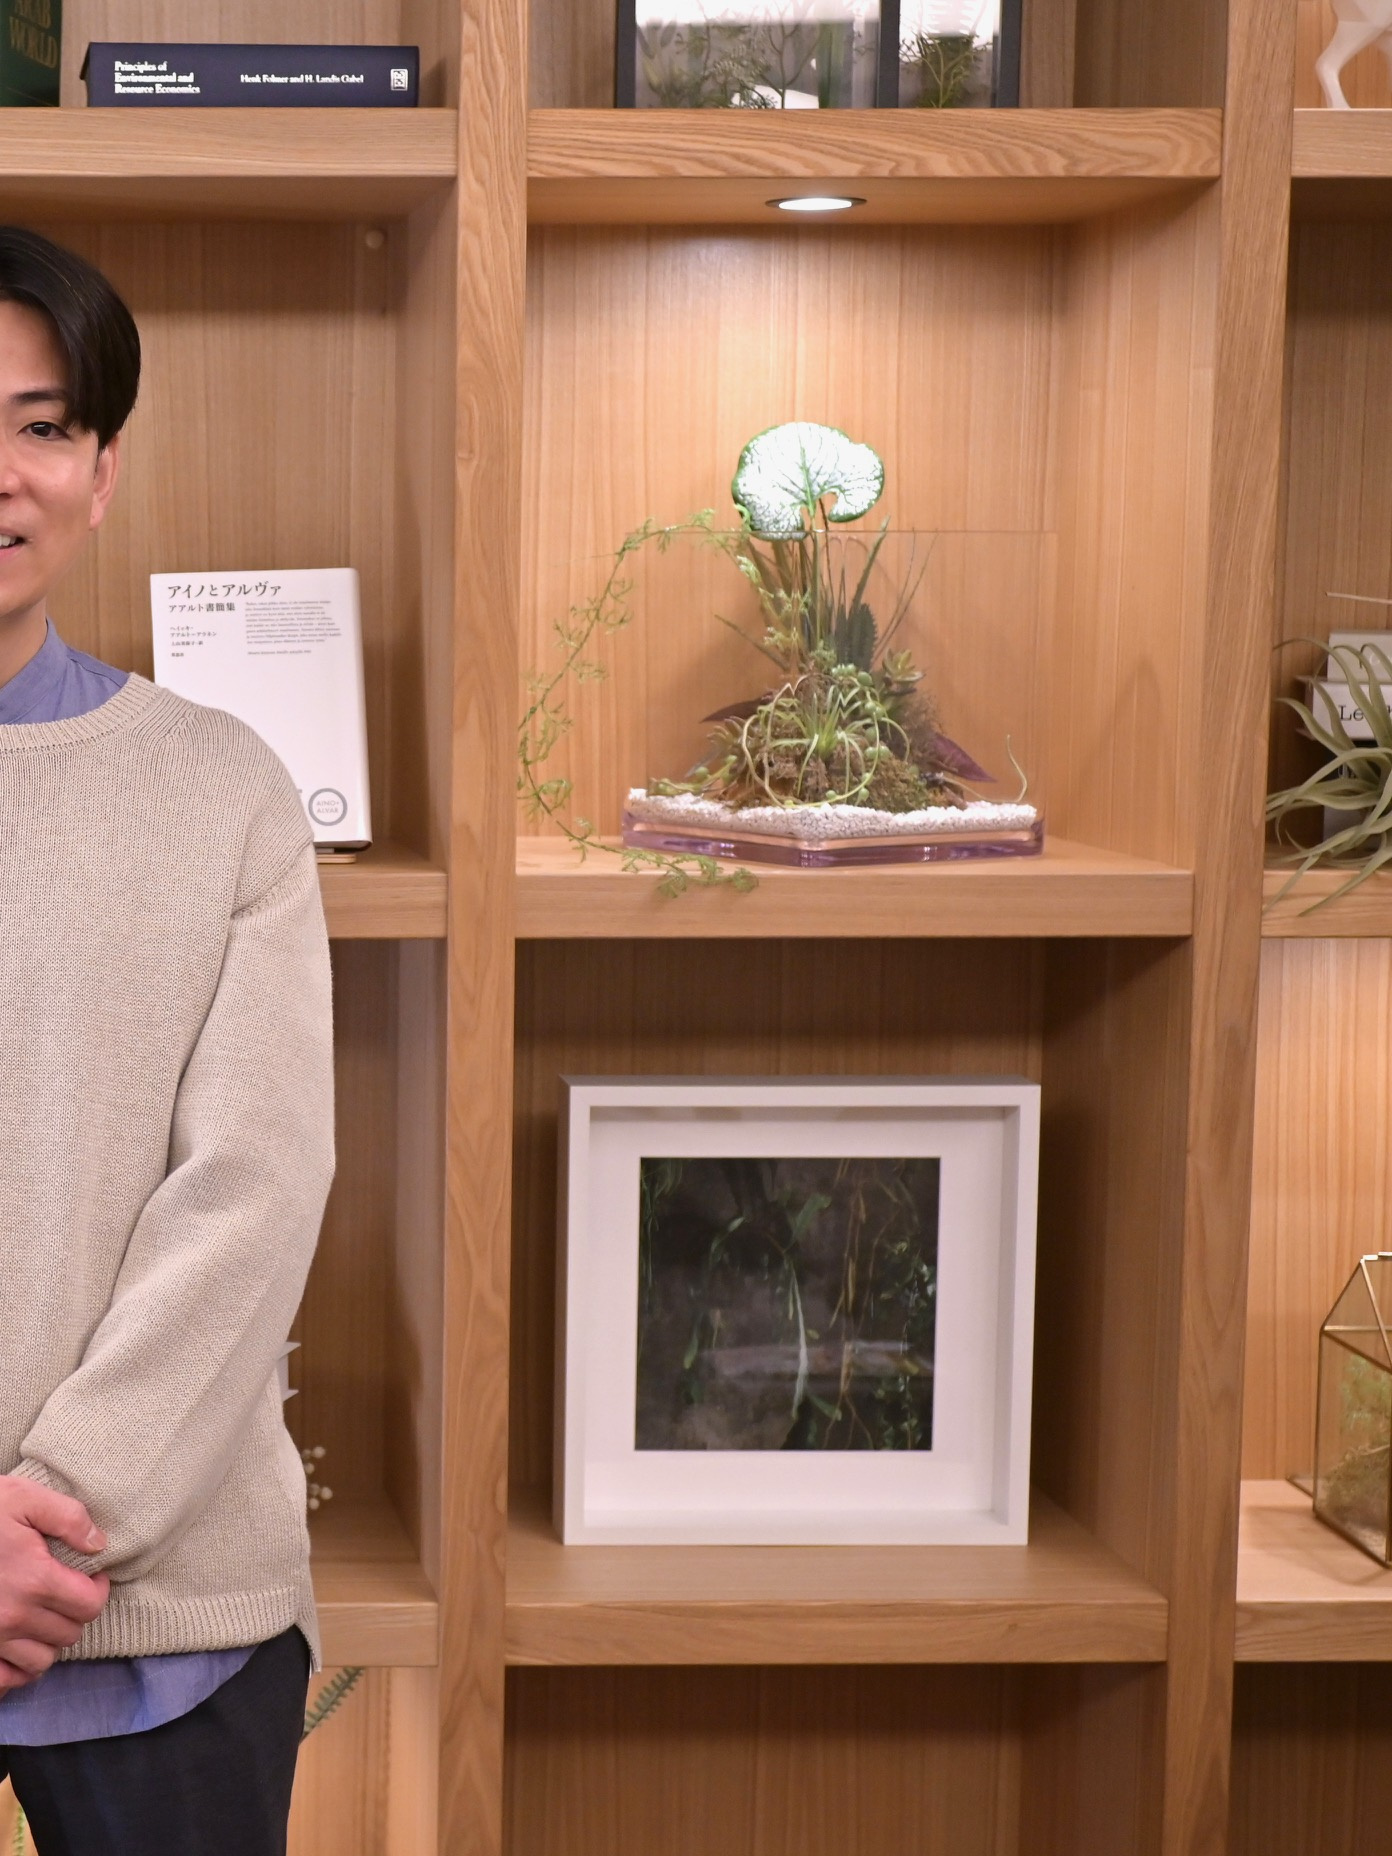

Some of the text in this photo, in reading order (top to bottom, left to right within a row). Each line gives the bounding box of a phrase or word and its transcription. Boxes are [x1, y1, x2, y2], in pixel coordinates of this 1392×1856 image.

[114, 60, 168, 73] Principles of
[114, 72, 195, 83] Environmental and
[240, 74, 262, 83] Henk
[289, 74, 304, 83] and
[114, 83, 201, 94] Resource Economics
[168, 580, 281, 599] アイノとアルヴァ
